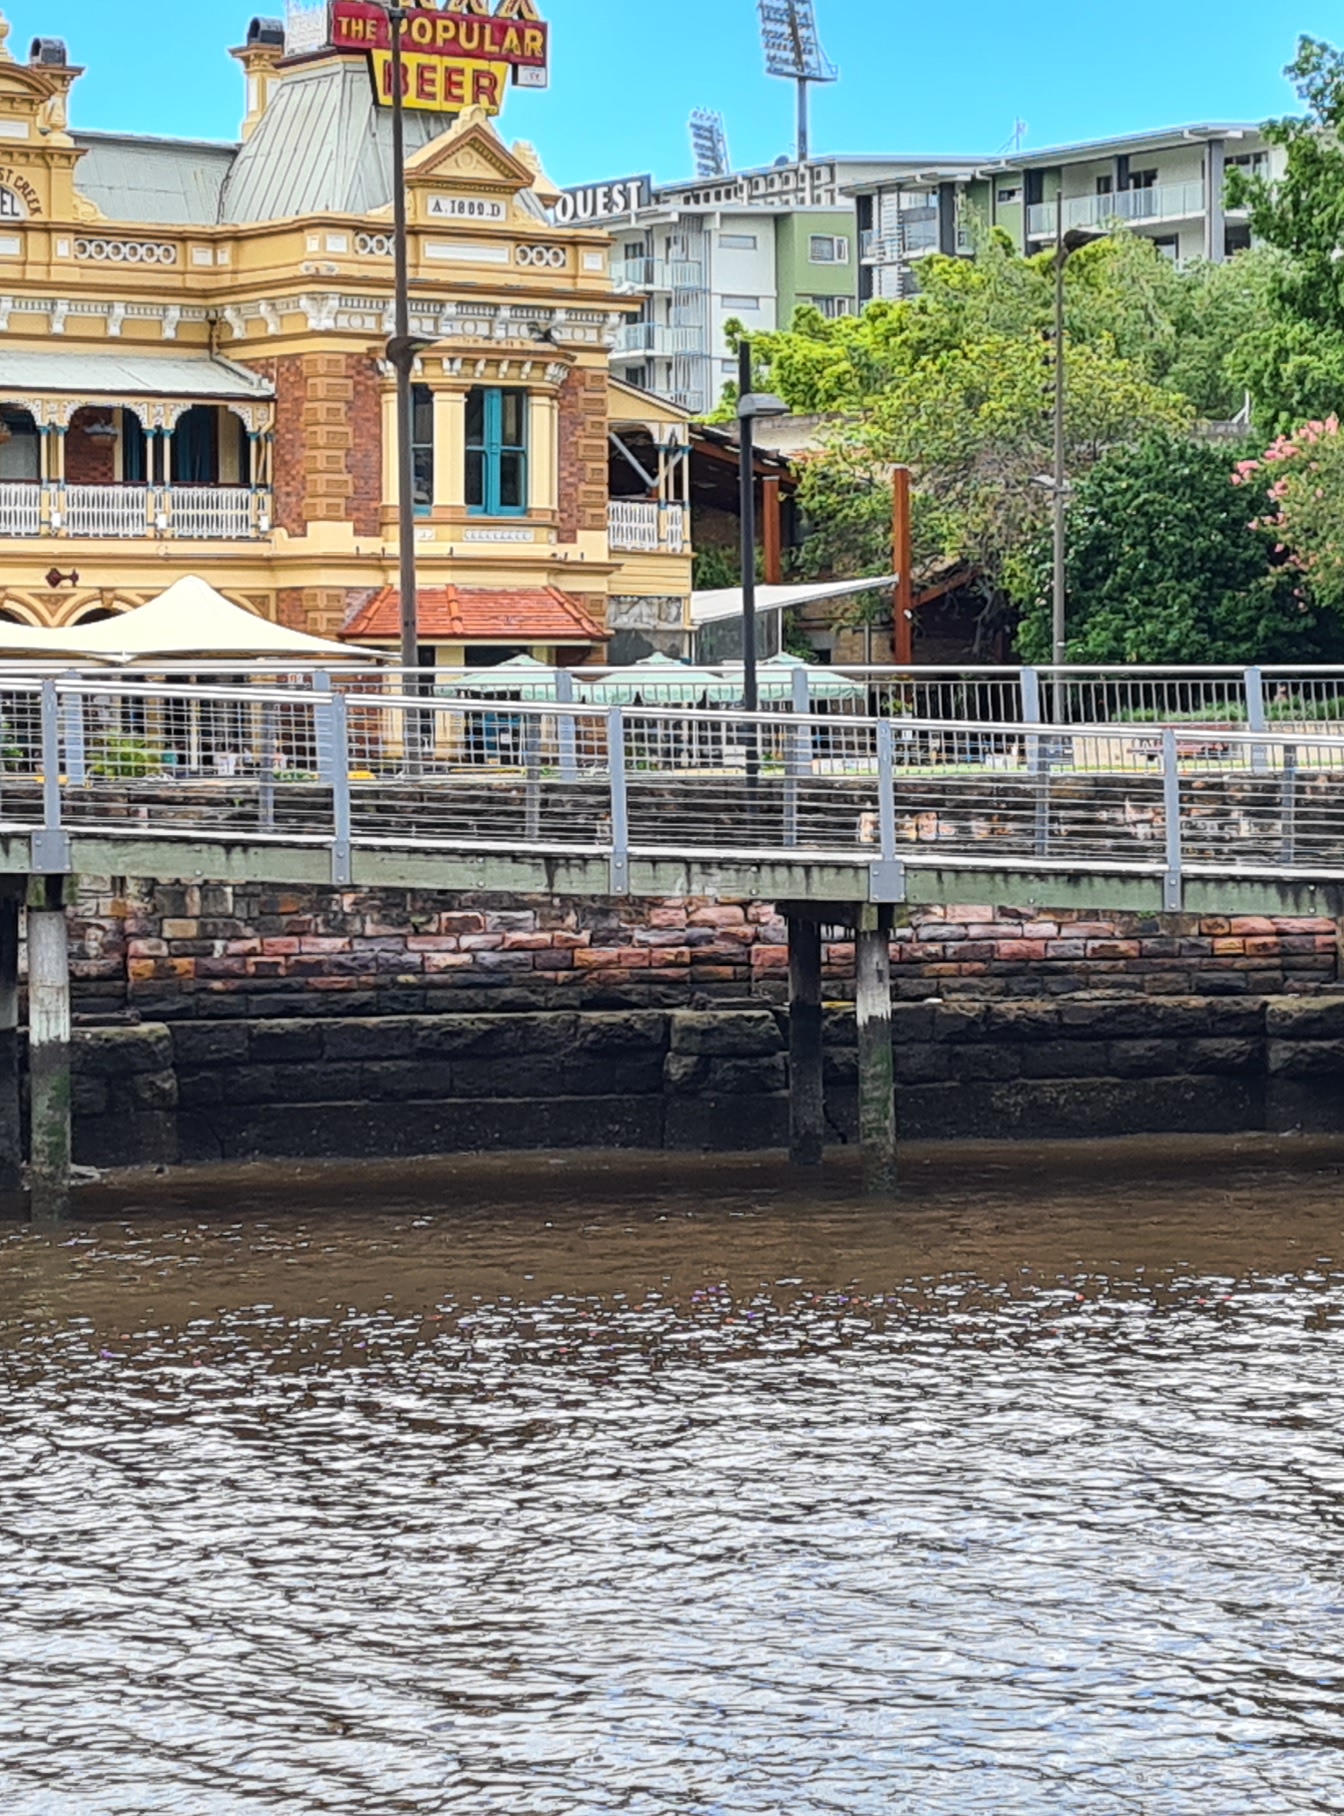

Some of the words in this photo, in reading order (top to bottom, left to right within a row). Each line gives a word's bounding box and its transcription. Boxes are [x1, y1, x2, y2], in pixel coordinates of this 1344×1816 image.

[338, 17, 378, 42] THE
[388, 16, 544, 57] POPULAR
[383, 59, 498, 105] BEER
[13, 175, 43, 217] CREEK
